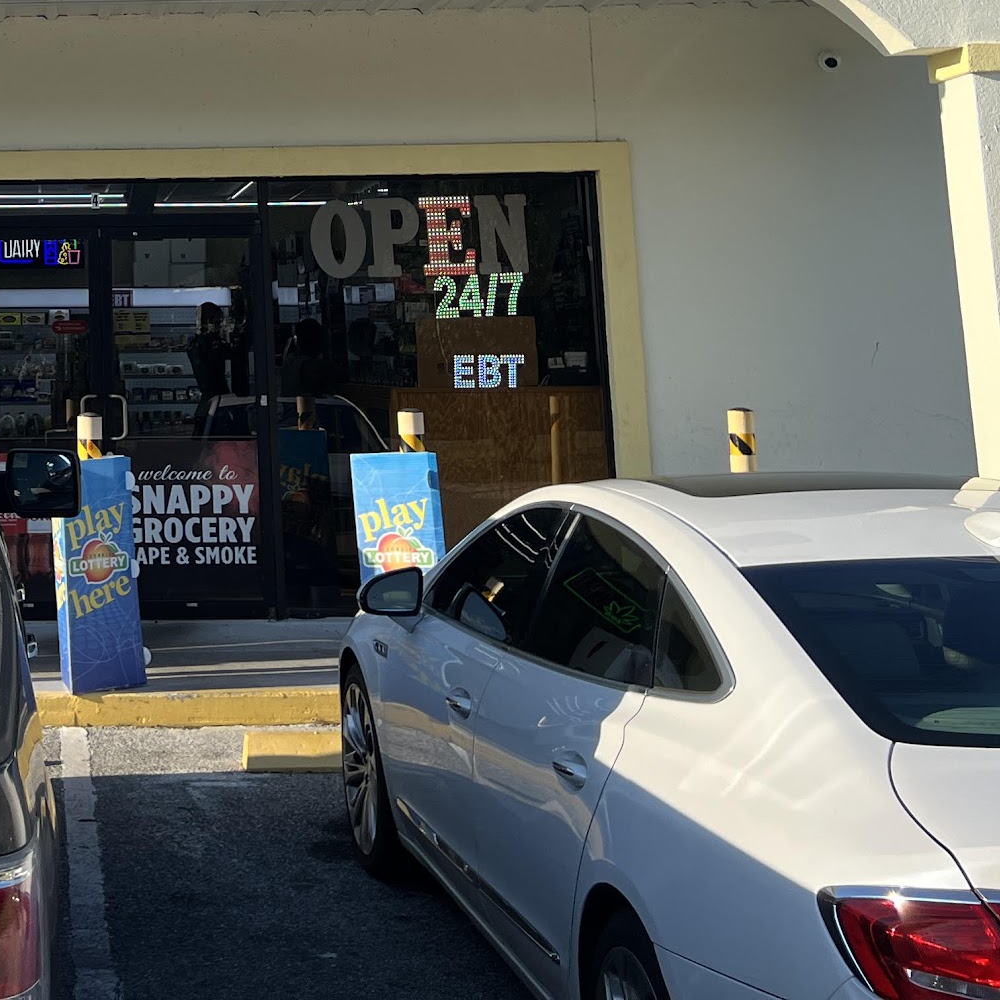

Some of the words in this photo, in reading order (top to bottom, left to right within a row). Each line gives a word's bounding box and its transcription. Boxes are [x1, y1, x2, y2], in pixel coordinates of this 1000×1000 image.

[310, 194, 530, 279] OPEN
[433, 272, 524, 319] 24/7
[453, 354, 525, 388] EBT
[138, 464, 213, 481] welcome
[218, 464, 238, 481] to
[65, 502, 126, 551] play
[358, 498, 428, 542] play
[72, 556, 127, 573] LOTTERY
[135, 546, 171, 566] APE
[176, 546, 190, 566] &
[194, 546, 257, 566] SMOKE
[366, 551, 430, 564] LOTTERY
[69, 575, 132, 619] here
